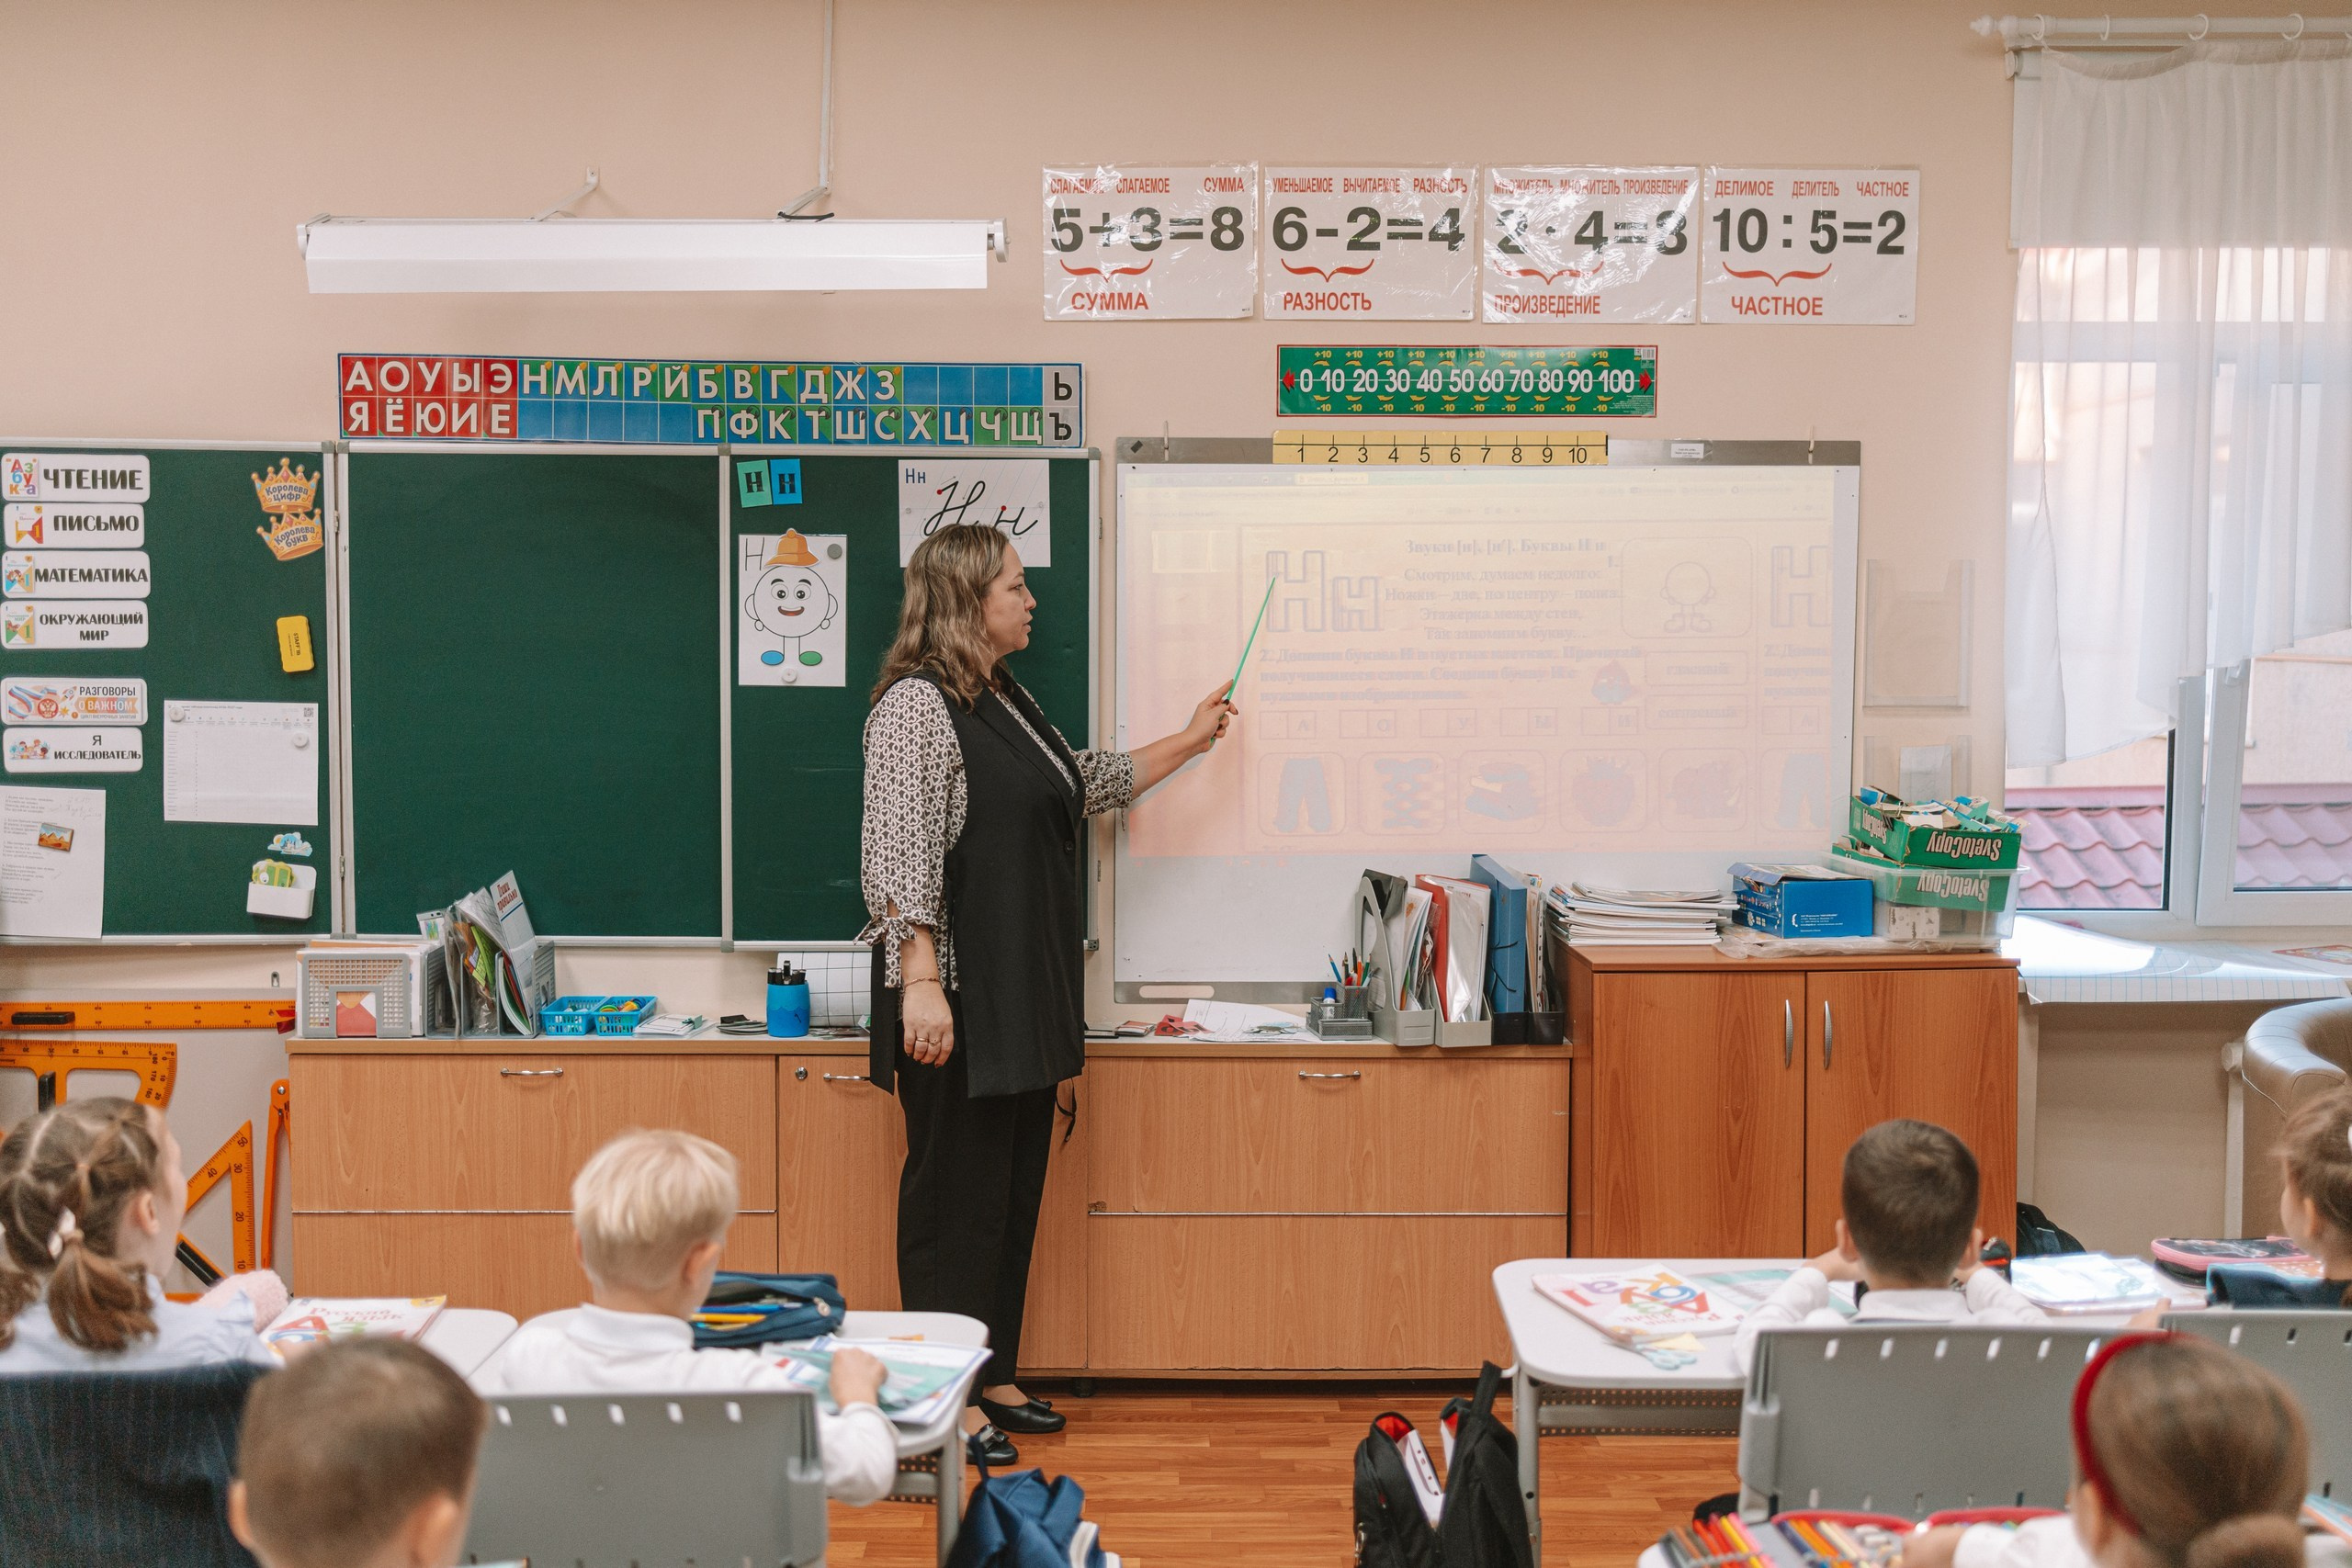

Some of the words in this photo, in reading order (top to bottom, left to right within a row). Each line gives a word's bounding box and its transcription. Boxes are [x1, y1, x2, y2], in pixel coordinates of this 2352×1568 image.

[1116, 178, 1170, 193] СЛАГАЕМОЕ
[1204, 177, 1245, 192] СУММА
[1272, 177, 1333, 193] УМЕНЬШАЕМОЕ
[1343, 177, 1400, 193] ВЫЧИТАЕМОЕ
[1413, 178, 1468, 193] РАЗНОСТЬ
[1623, 179, 1689, 196] ПРОИЗВЕДЕНИЕ
[1714, 180, 1774, 197] ДЕЛИМОЕ
[1792, 181, 1839, 197] ДЕЛИТЕЛЬ
[1856, 181, 1909, 197] ЧАСТНОЕ
[1071, 292, 1148, 310] СУММА
[1283, 292, 1373, 310] РАЗНОСТЬ
[1495, 294, 1600, 318] ПРОИЗВЕДЕНИЕ
[1731, 296, 1824, 316] ЧАСТНОЕ
[345, 361, 373, 392] А
[379, 361, 410, 393] О
[417, 361, 442, 392] У
[453, 363, 481, 394] Ы
[490, 363, 514, 395] Э
[523, 364, 548, 396] Н
[555, 364, 586, 396] М
[593, 366, 617, 397] Л
[633, 367, 653, 397] Р
[665, 364, 689, 399] Й
[699, 368, 718, 399] Б
[735, 369, 754, 399] В
[771, 369, 788, 400] Г
[800, 369, 828, 403] Д
[833, 370, 866, 400] Ж
[876, 370, 895, 400] З
[1054, 372, 1073, 401] Ь
[1300, 369, 1313, 393] 0
[1321, 369, 1345, 393] 10
[1352, 369, 1378, 393] 20
[1385, 369, 1410, 393] 30
[1416, 369, 1442, 393] 40
[1449, 369, 1474, 393] 50
[1478, 369, 1504, 393] 60
[1510, 369, 1534, 393] 70
[1538, 369, 1563, 393] 80
[1567, 369, 1593, 393] 90
[1599, 369, 1634, 393] 100
[348, 401, 368, 432] Я
[387, 398, 404, 433] Ё
[416, 401, 447, 433] Ю
[452, 402, 477, 434] И
[491, 404, 511, 434] Е
[697, 409, 720, 440] П
[729, 409, 758, 440] Ф
[770, 410, 793, 439] К
[806, 411, 828, 439] Т
[836, 411, 865, 439] Ш
[875, 411, 896, 441] С
[908, 411, 933, 440] Х
[944, 412, 969, 445] Ц
[979, 412, 1001, 441] Ч
[1011, 412, 1044, 445] Щ
[1048, 412, 1073, 441] Ъ
[1297, 447, 1304, 463] 1
[1329, 447, 1339, 463] 2
[1358, 447, 1368, 463] 3
[1388, 447, 1399, 463] 4
[1419, 447, 1430, 463] 5
[1450, 447, 1461, 463] 6
[1481, 447, 1491, 463] 7
[1511, 447, 1522, 463] 8
[1542, 447, 1553, 463] 9
[1568, 447, 1588, 463] 10
[43, 468, 143, 490] ЧТЕНИЕ
[744, 471, 764, 493] Н
[778, 473, 797, 494] Н
[266, 485, 309, 495] Королева
[273, 492, 300, 502] цифр
[53, 515, 139, 531] ПИСЬМО
[274, 526, 315, 545] Королева
[286, 535, 308, 547] букв
[1407, 539, 1455, 556] Звуки
[1521, 538, 1572, 554] Буквы
[34, 568, 148, 582] МАТЕМАТИКА
[1478, 570, 1536, 583] думаем
[40, 612, 143, 626] ОКРУЖАЮЩИЙ
[79, 630, 109, 641] МИР
[80, 686, 136, 696] РАЗГОВОРЫ
[79, 701, 85, 710] О
[87, 700, 133, 711] ВАЖНОМ
[93, 735, 102, 746] Я
[54, 750, 141, 761] ИССЛЕДОВАТЕЛЬ
[1926, 830, 2003, 862] SvetoCopy
[237, 1136, 249, 1147] 50
[207, 1168, 218, 1179] 40
[234, 1163, 243, 1173] 30
[235, 1212, 244, 1222] 20
[237, 1259, 245, 1269] 10
